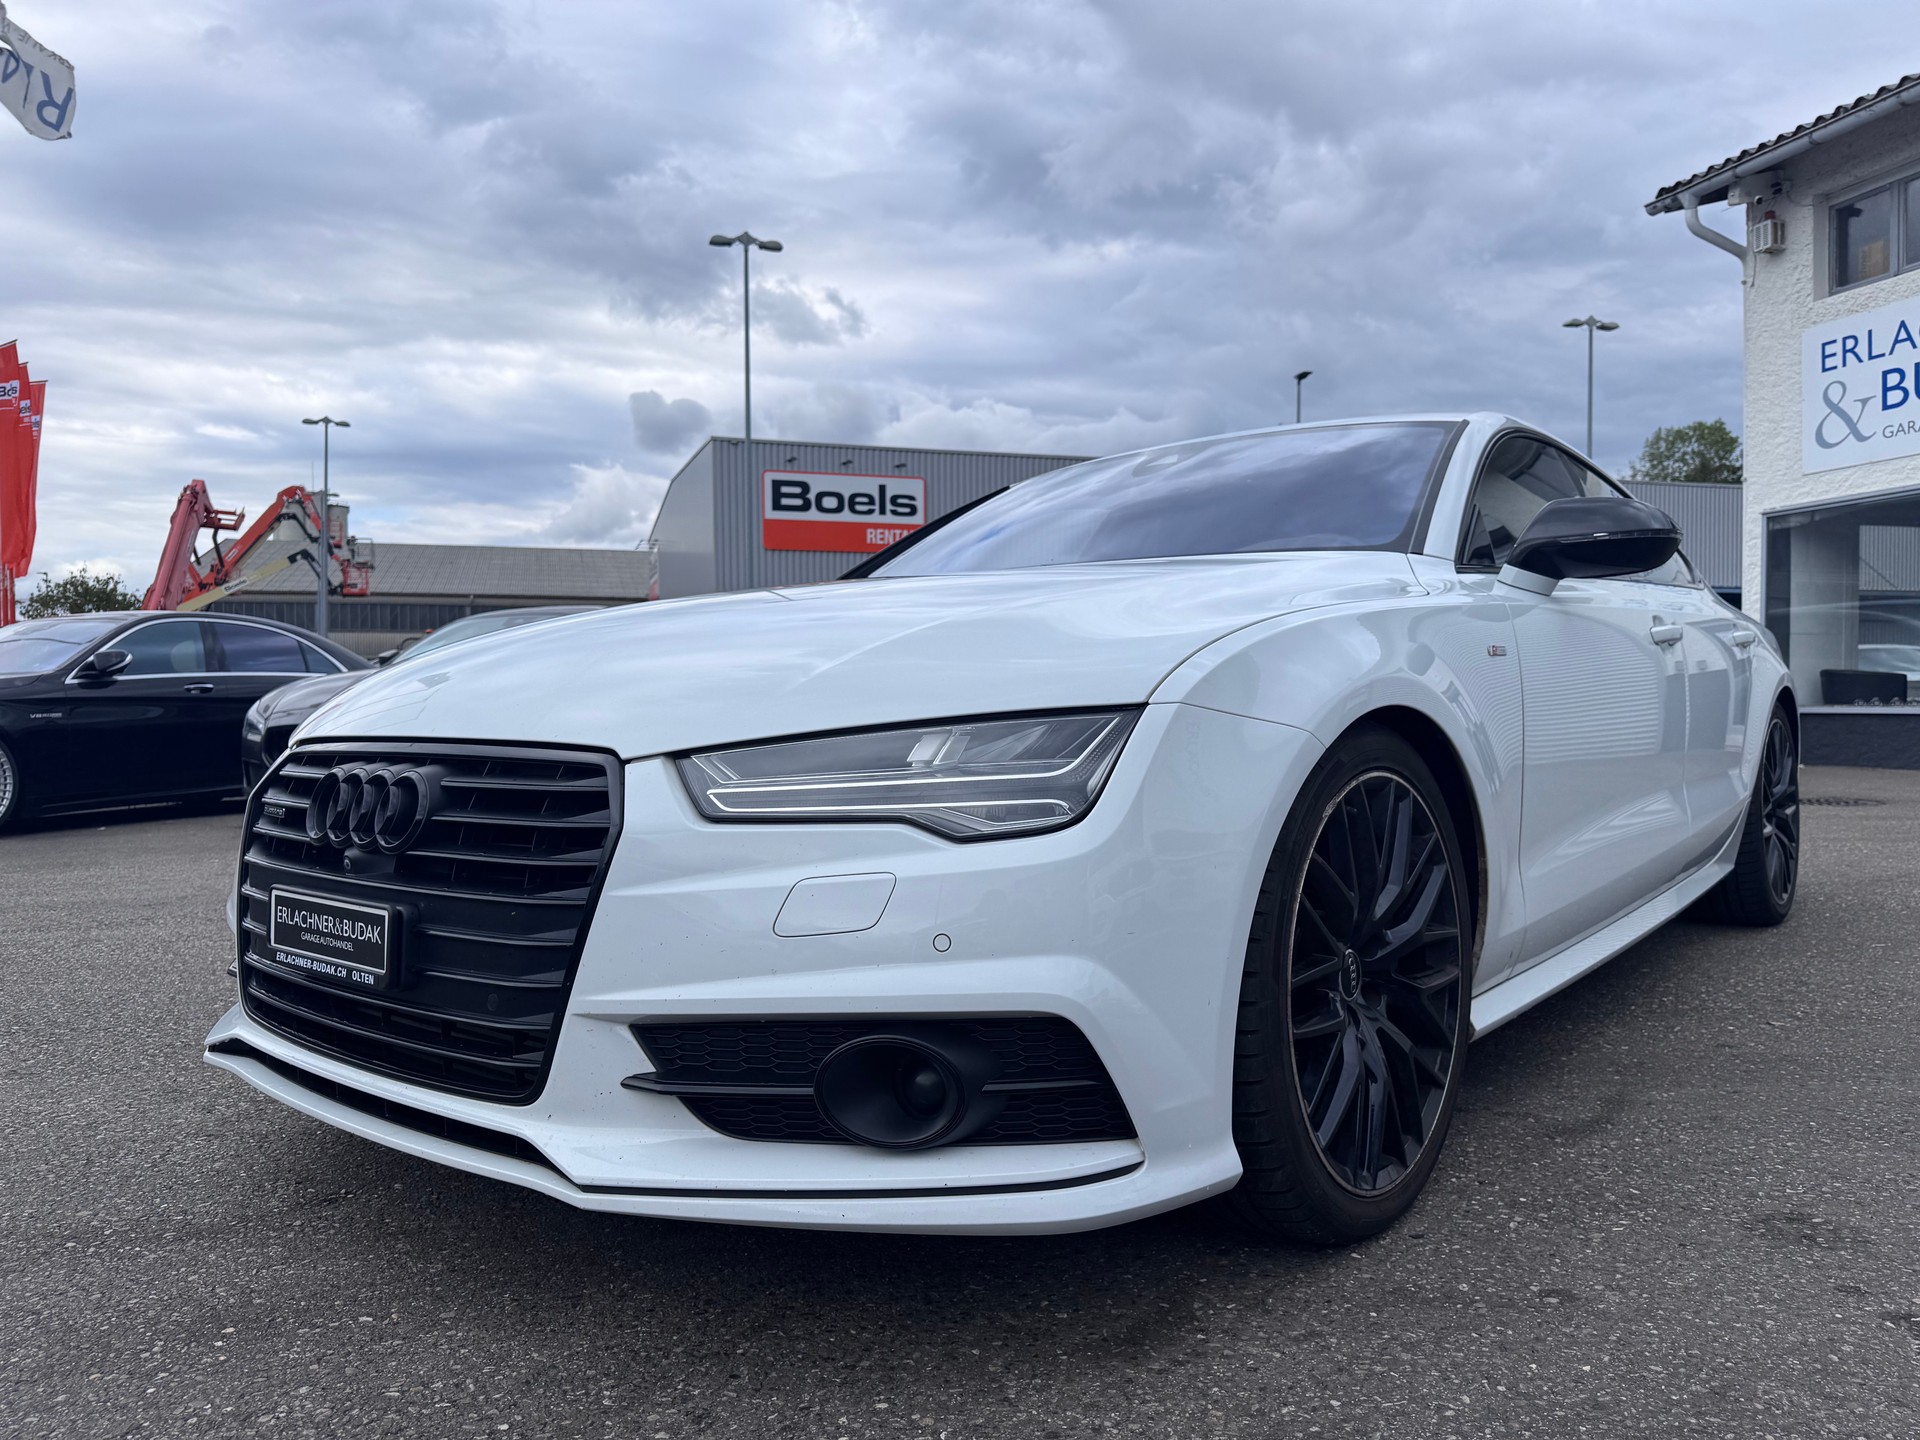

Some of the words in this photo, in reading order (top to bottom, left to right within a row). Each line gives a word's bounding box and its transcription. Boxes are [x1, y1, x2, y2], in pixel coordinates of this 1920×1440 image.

[1821, 320, 1920, 373] ERLA
[1815, 380, 1877, 449] &
[1881, 361, 1920, 411] B
[1882, 420, 1920, 438] GAR
[771, 479, 918, 516] Boels
[866, 528, 912, 544] RENTA
[276, 951, 347, 978] ERLACHNER-BUDAK.CH
[351, 970, 375, 985] OLTEN
